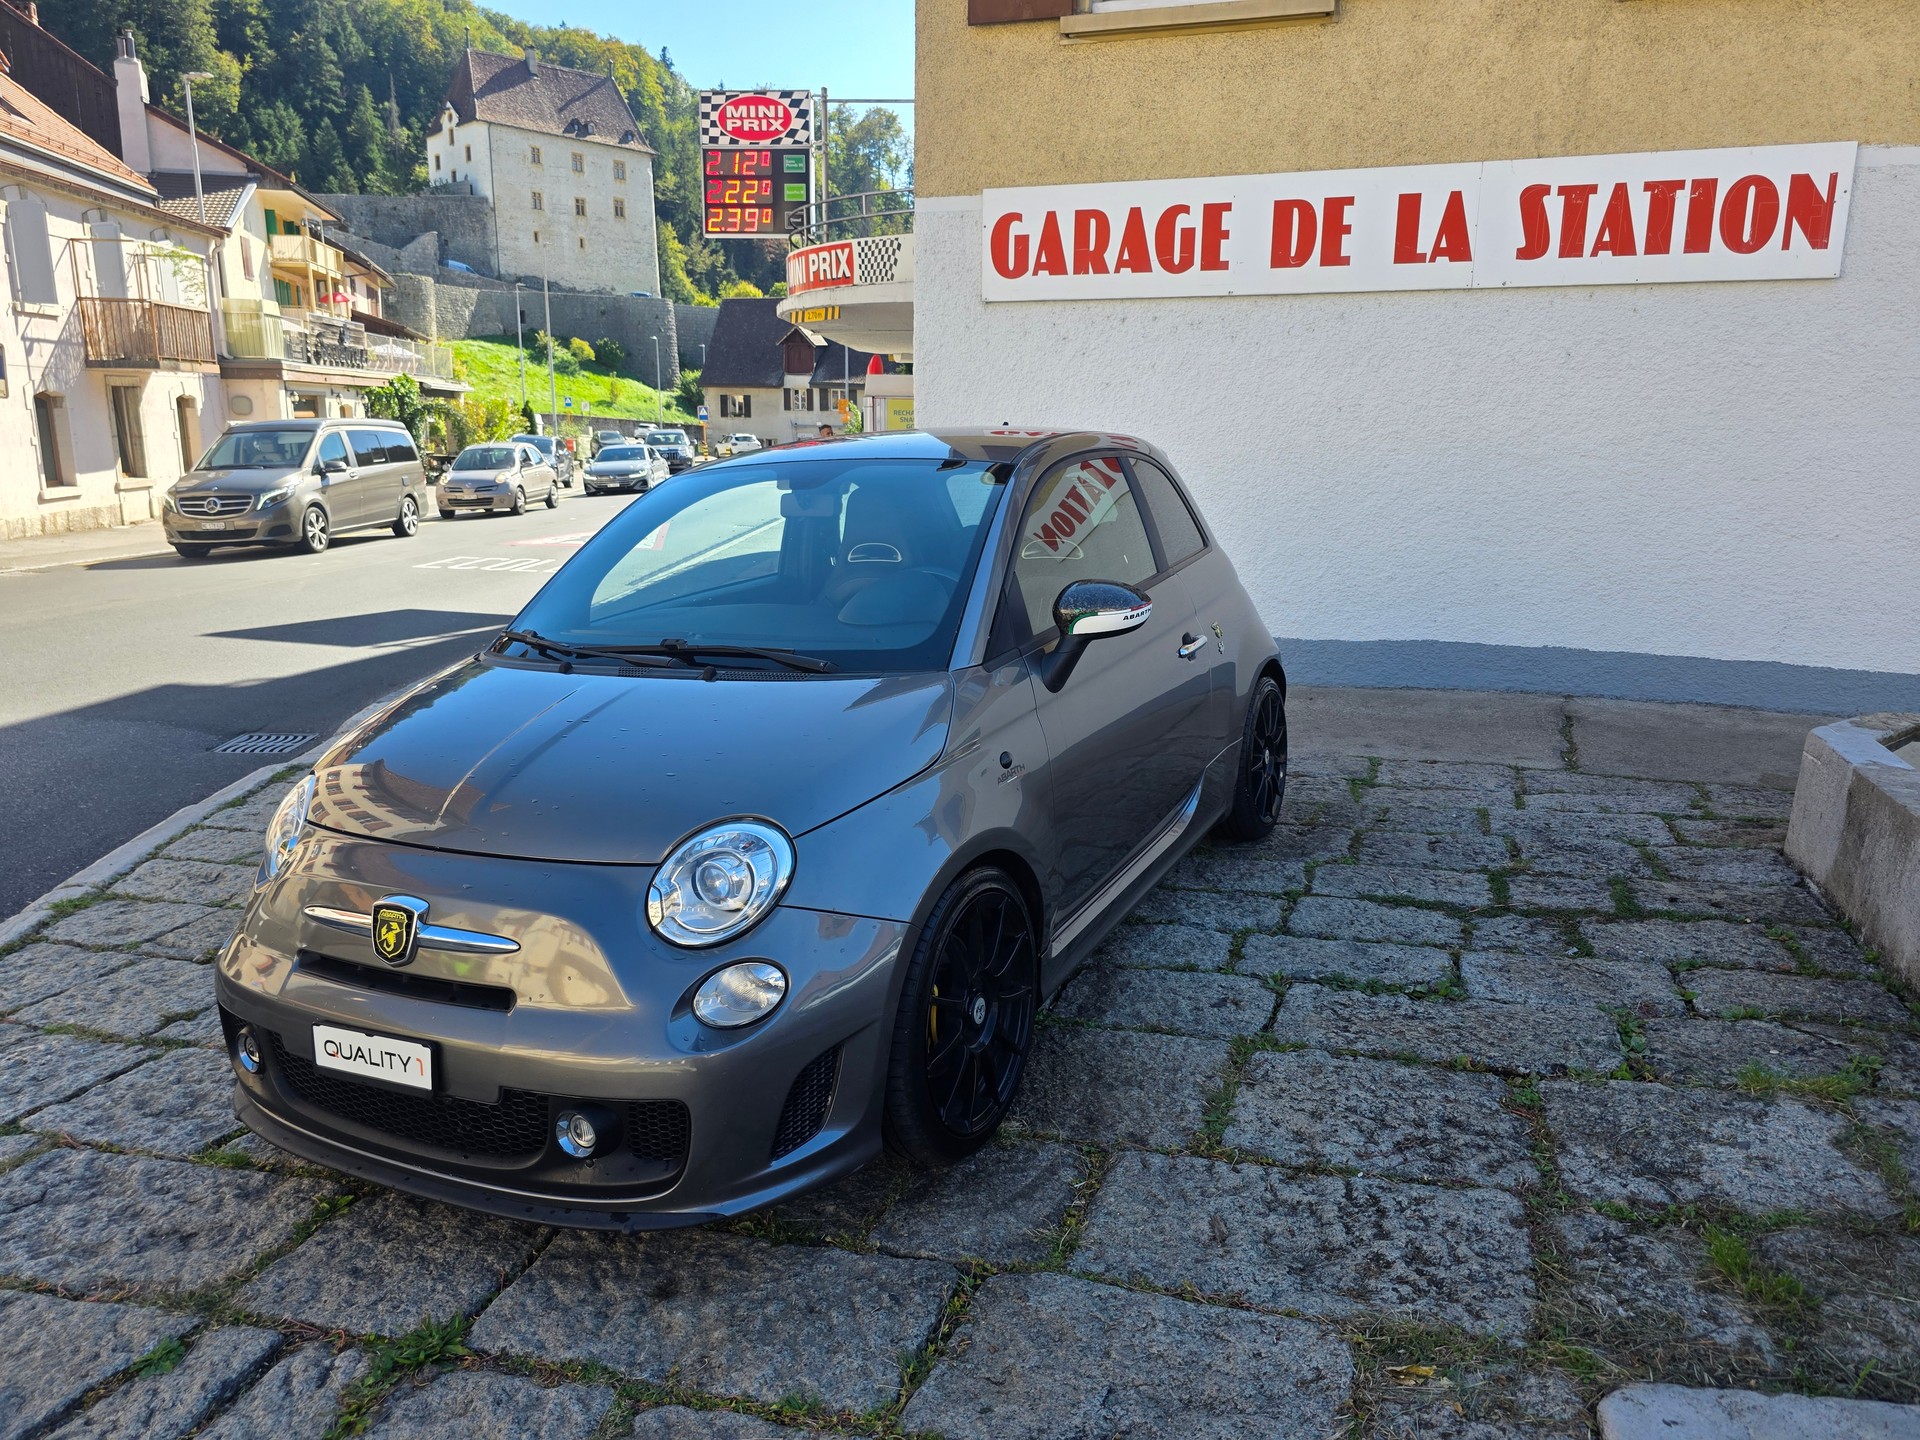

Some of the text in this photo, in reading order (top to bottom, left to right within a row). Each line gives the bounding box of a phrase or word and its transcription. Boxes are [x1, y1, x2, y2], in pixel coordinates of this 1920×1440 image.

[726, 105, 784, 118] MINI
[726, 118, 785, 132] PRIX
[990, 172, 1839, 280] GARAGE DE LA STATION
[808, 247, 851, 282] PRIX
[1122, 606, 1152, 621] ABARTH
[997, 763, 1026, 785] ABARTH
[324, 1039, 411, 1073] QUALITY
